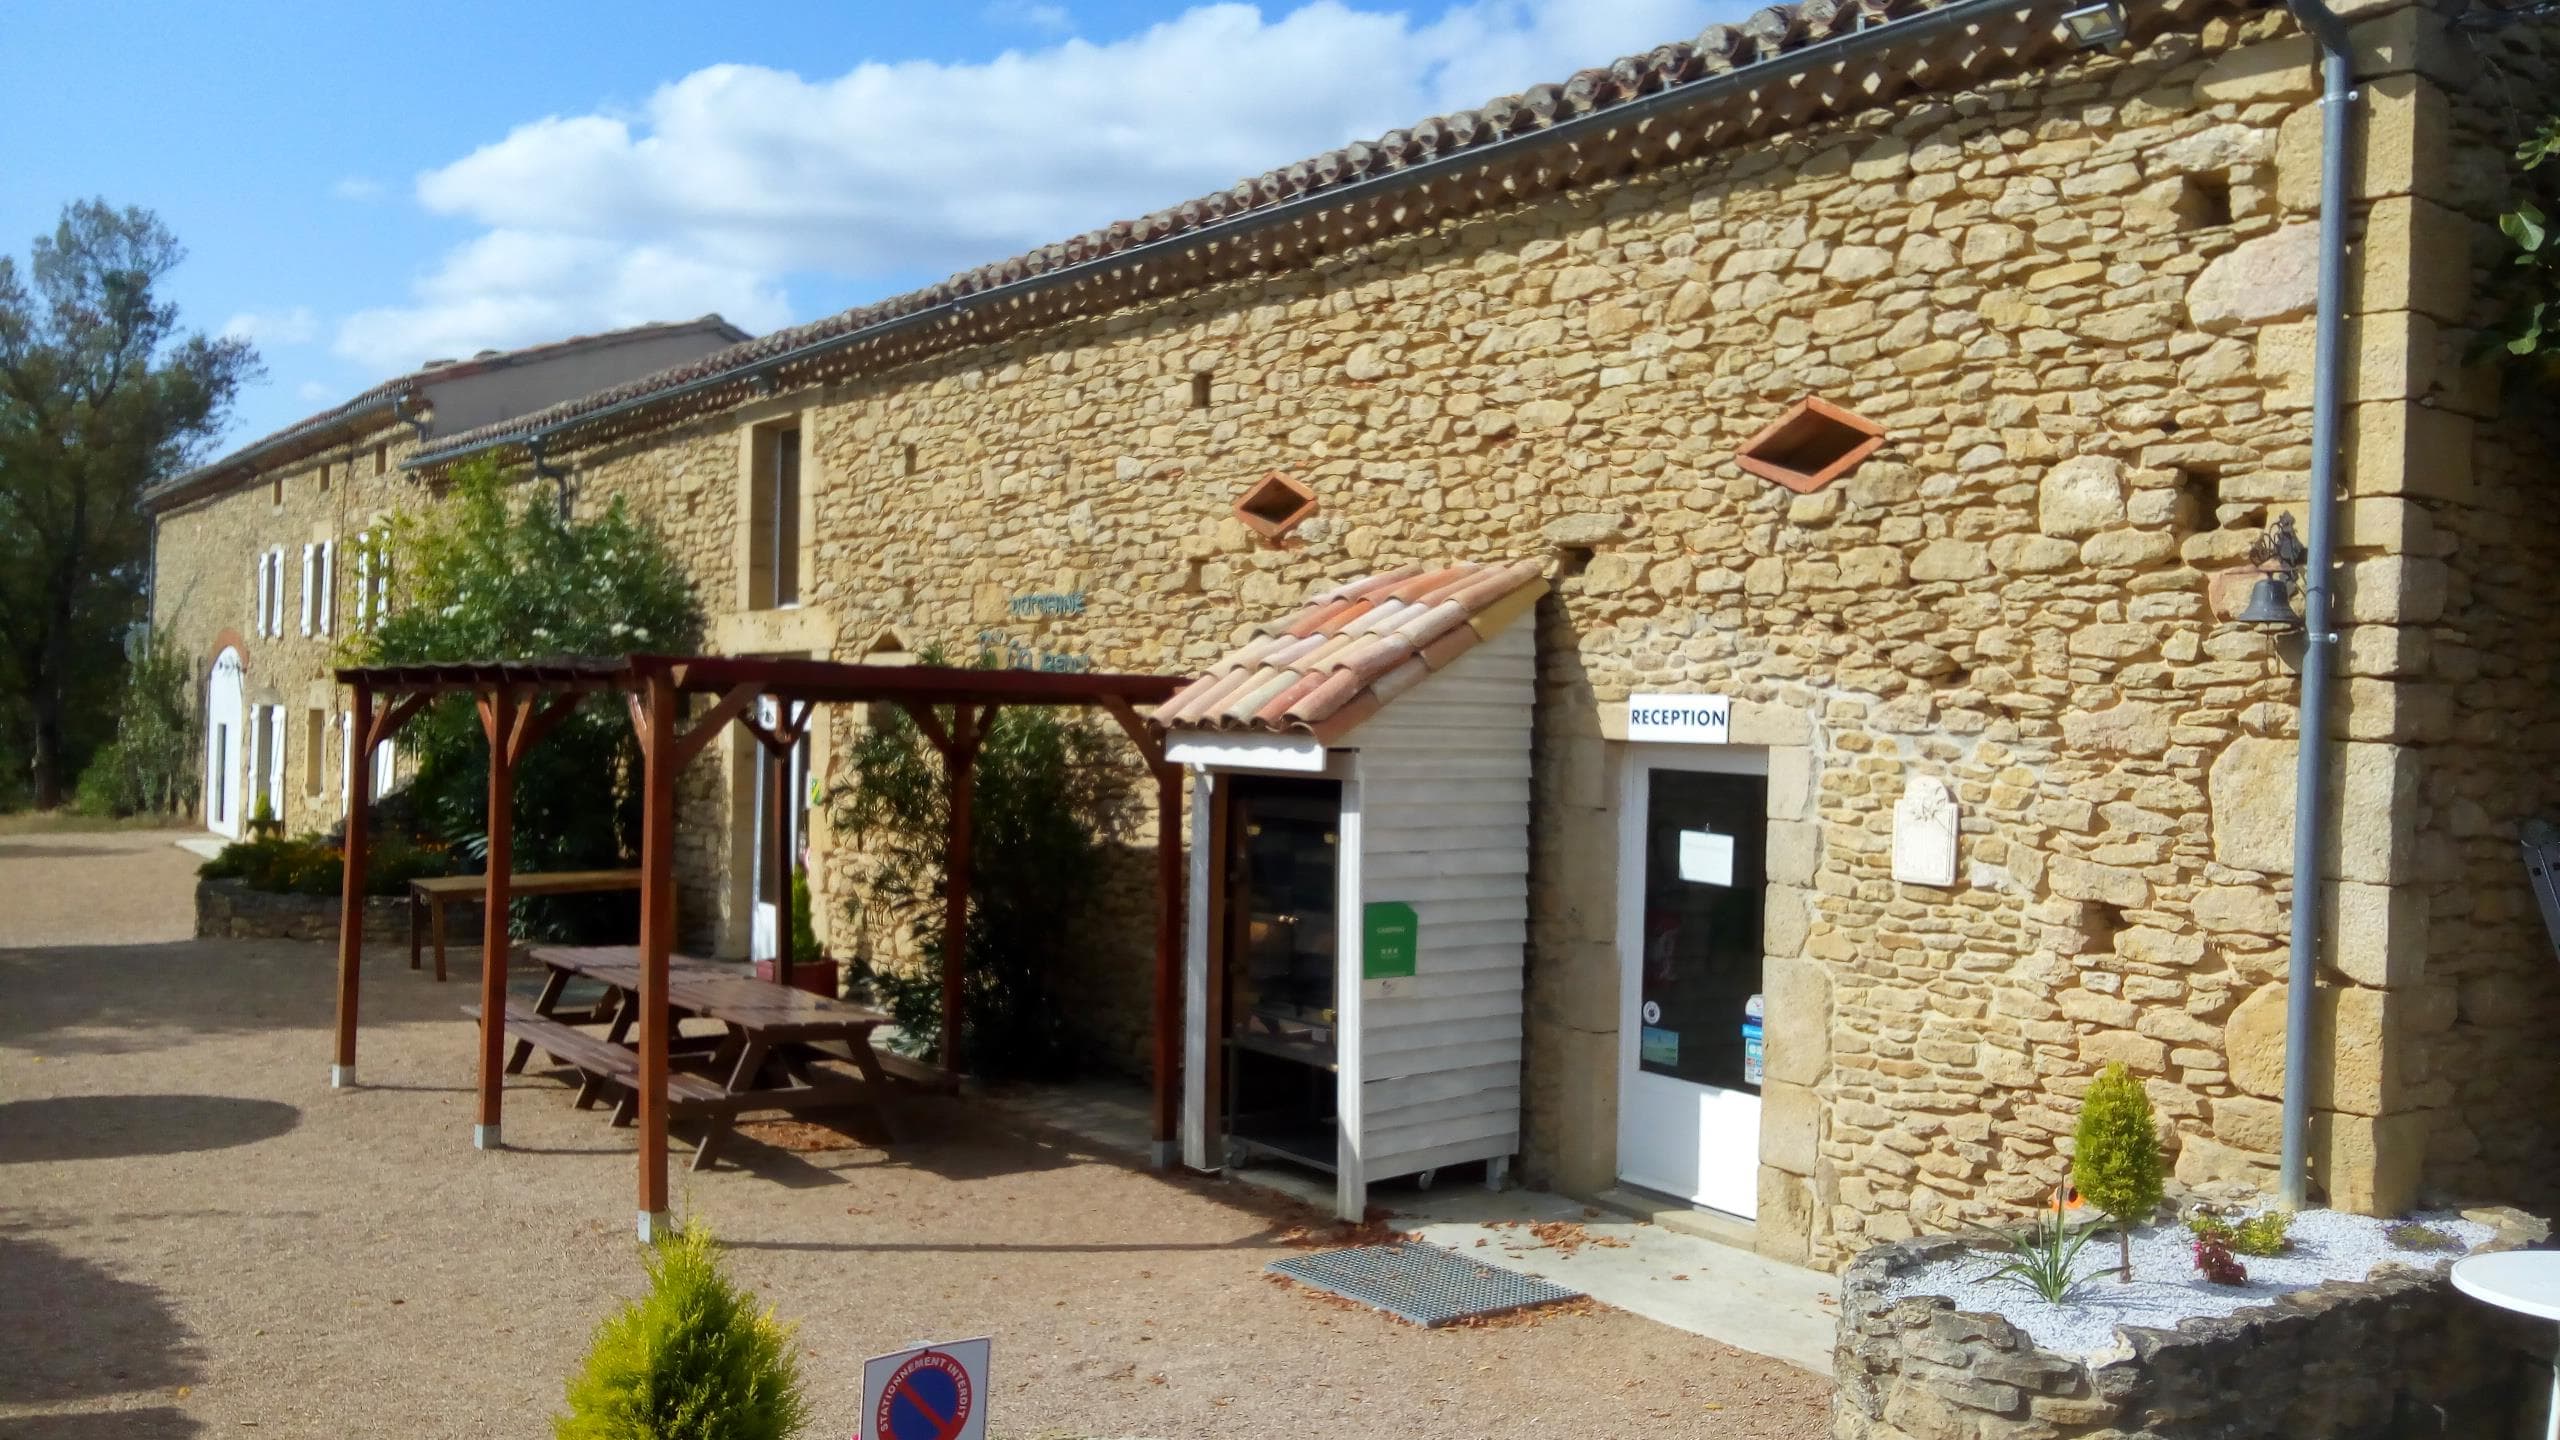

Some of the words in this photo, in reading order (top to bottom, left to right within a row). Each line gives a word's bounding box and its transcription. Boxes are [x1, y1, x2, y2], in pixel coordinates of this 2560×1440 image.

[1631, 708, 1726, 727] RECEPTION
[880, 1356, 949, 1432] STATIONNEMENT
[947, 1363, 969, 1419] INTERDIT
